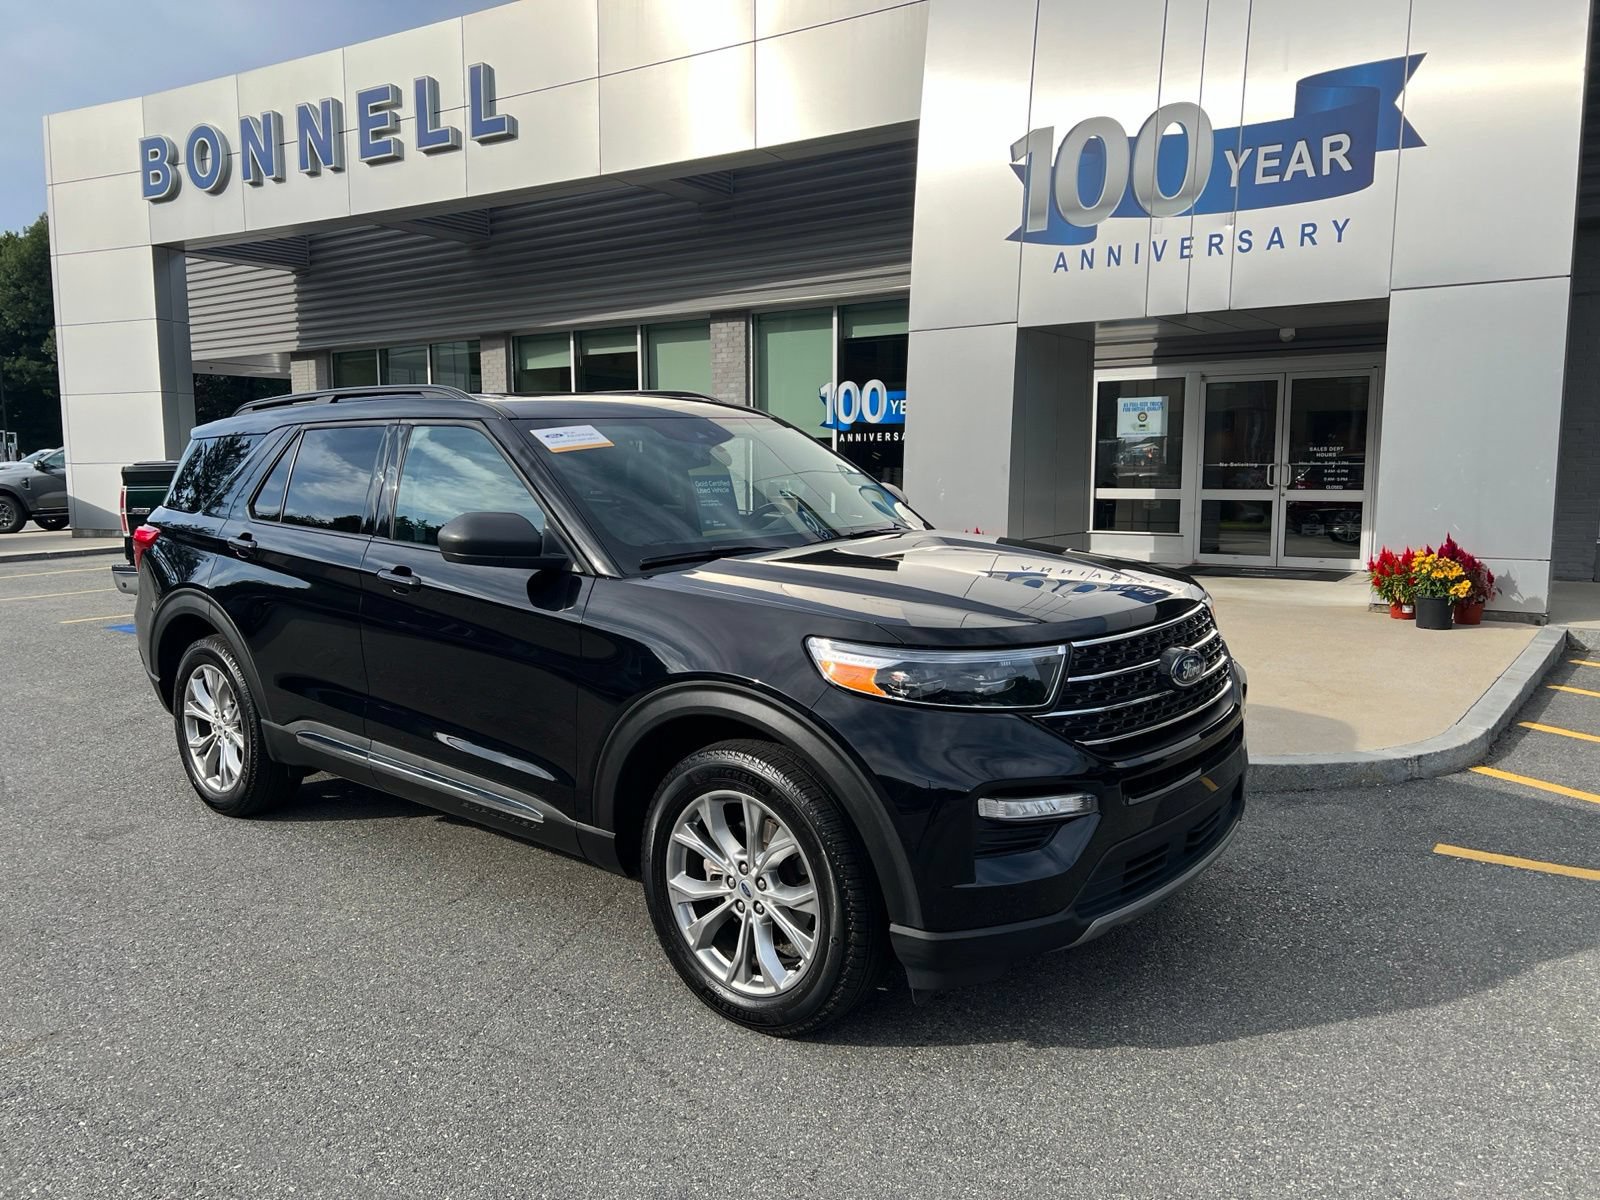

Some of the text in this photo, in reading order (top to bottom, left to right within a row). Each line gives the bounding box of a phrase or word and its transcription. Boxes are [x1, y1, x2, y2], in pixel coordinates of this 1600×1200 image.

[138, 62, 518, 204] BONNELL
[1009, 101, 1354, 233] 100 YEAR
[1052, 217, 1352, 274] ANNIVERSARY
[819, 378, 888, 425] 100
